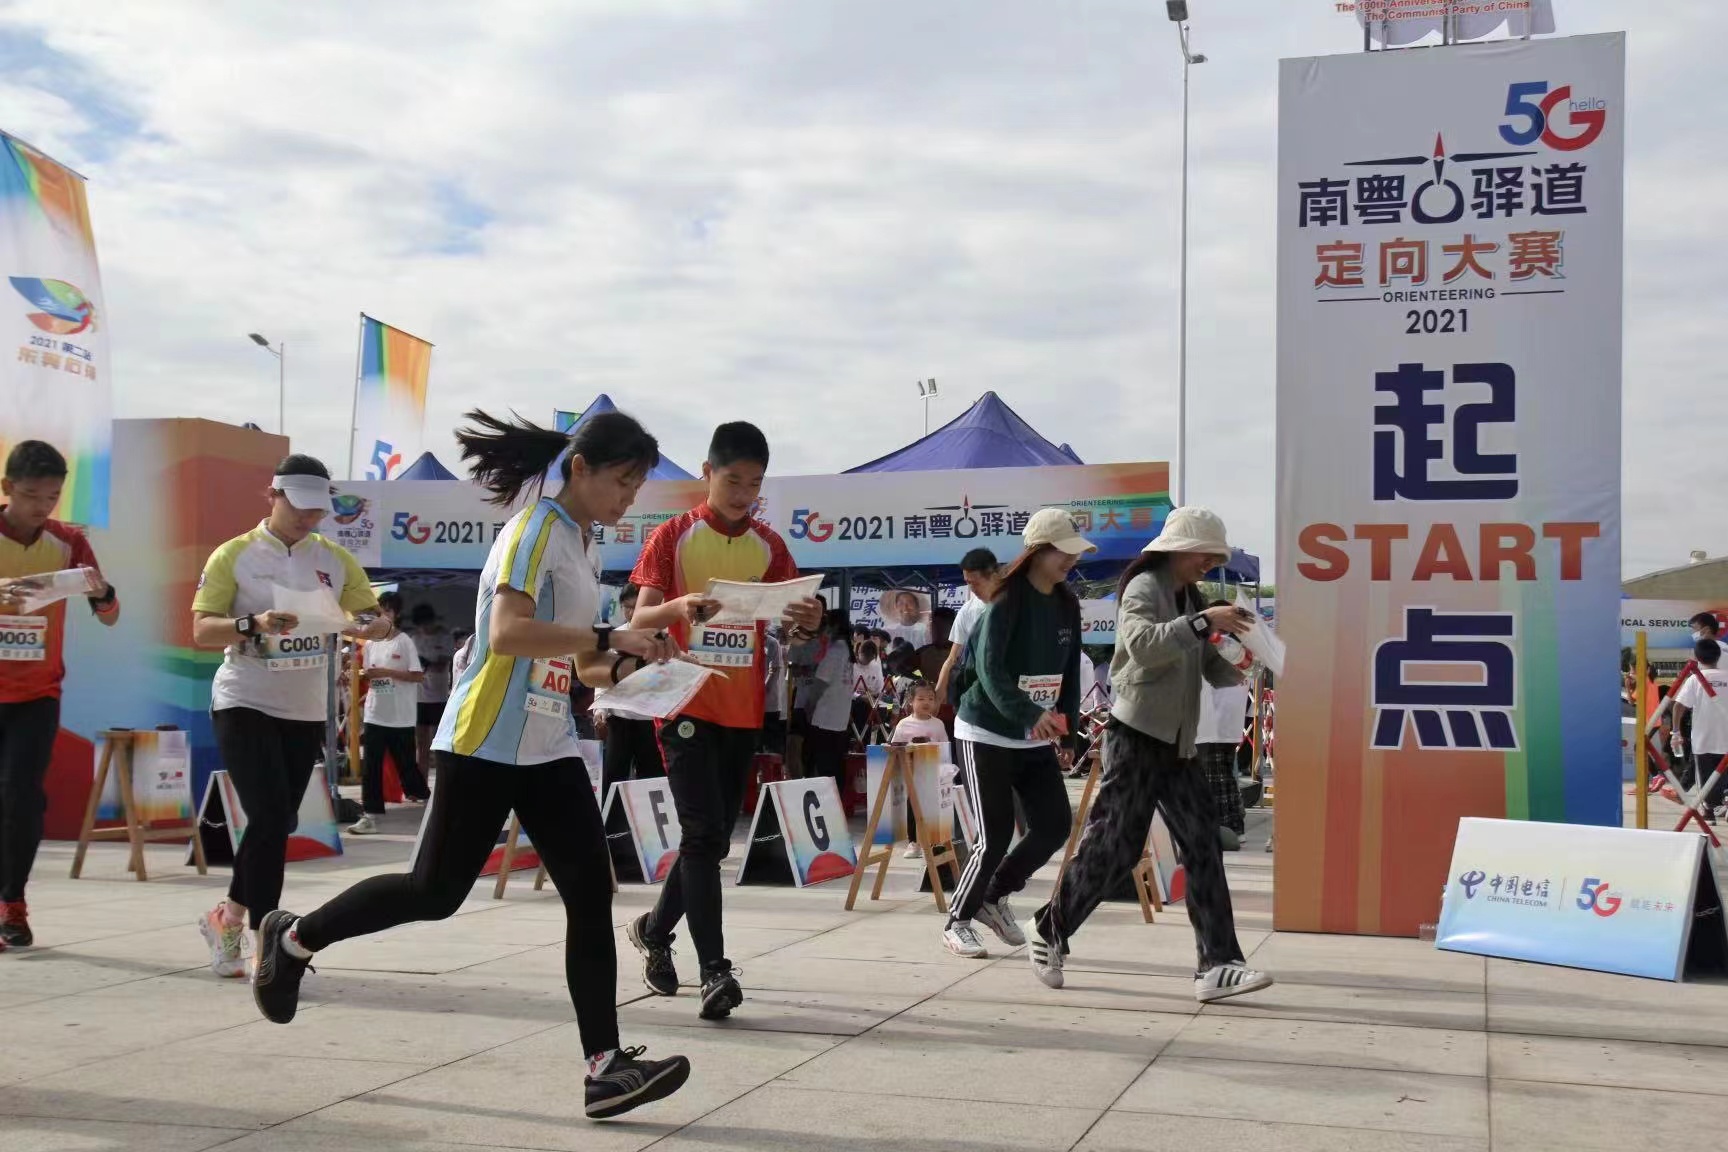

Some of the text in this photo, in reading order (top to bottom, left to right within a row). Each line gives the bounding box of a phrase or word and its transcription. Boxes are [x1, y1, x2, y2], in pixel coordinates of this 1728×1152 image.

[1336, 3, 1355, 12] The
[1366, 12, 1387, 21] The
[1388, 8, 1449, 20] Communist
[1452, 6, 1481, 16] Party
[1499, 1, 1530, 10] China
[1498, 80, 1606, 152] 5G
[1569, 97, 1606, 111] hello
[1313, 230, 1565, 290] 定向大赛
[1382, 287, 1496, 304] ORIENTEERING
[1405, 308, 1469, 335] 2021
[1372, 361, 1519, 501] 起
[391, 512, 431, 544] 5G
[434, 521, 484, 543] 2021
[788, 508, 834, 543] 5G
[838, 515, 894, 541] 2021
[1070, 508, 1152, 532] 向大赛
[1296, 521, 1601, 582] START
[1093, 619, 1116, 632] 202
[279, 635, 320, 653] C003
[703, 631, 748, 648] E003
[1371, 606, 1519, 750] 点
[1032, 688, 1058, 703] 03-1
[648, 789, 670, 850] F
[802, 790, 831, 851] G
[1489, 873, 1551, 898] 中国电信
[1575, 877, 1622, 918] 5G
[1486, 895, 1548, 907] CHINA TELECOM
